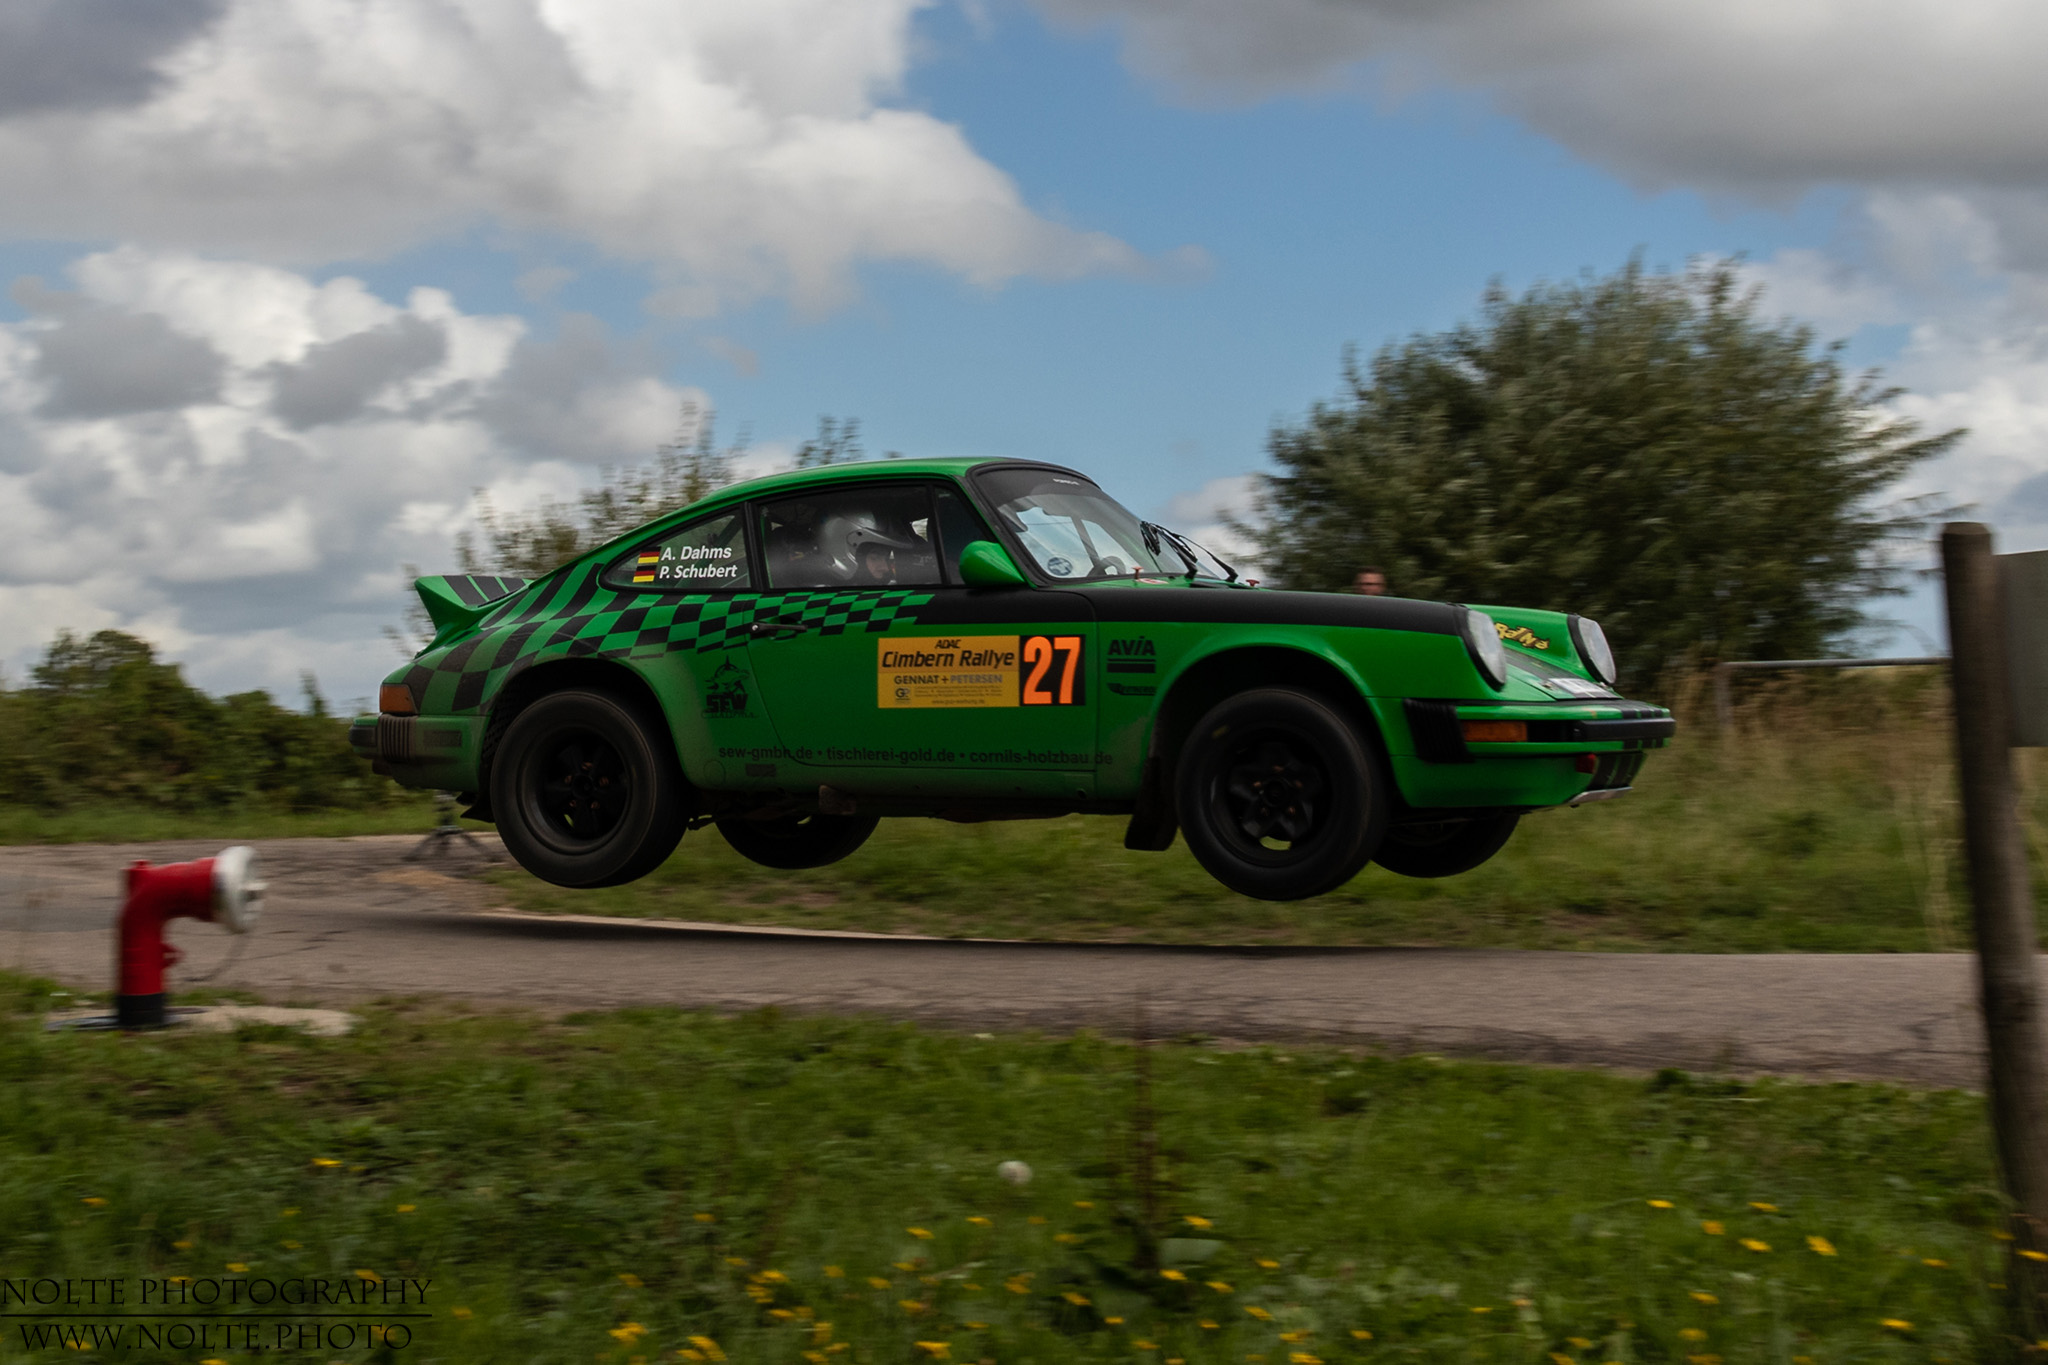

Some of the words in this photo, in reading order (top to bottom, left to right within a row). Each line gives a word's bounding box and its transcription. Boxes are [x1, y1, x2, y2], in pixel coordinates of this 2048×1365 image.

[661, 547, 676, 561] A.
[681, 545, 732, 560] Dahms
[659, 565, 670, 579] P.
[674, 563, 738, 579] Schubert
[934, 639, 961, 649] ADAC
[882, 651, 955, 668] Cimbern
[959, 650, 1014, 669] Rallye
[1023, 636, 1081, 705] 27
[894, 675, 939, 685] GENNAT
[950, 674, 1003, 684] PETERSEN
[827, 747, 955, 764] tischlerei-gold.de
